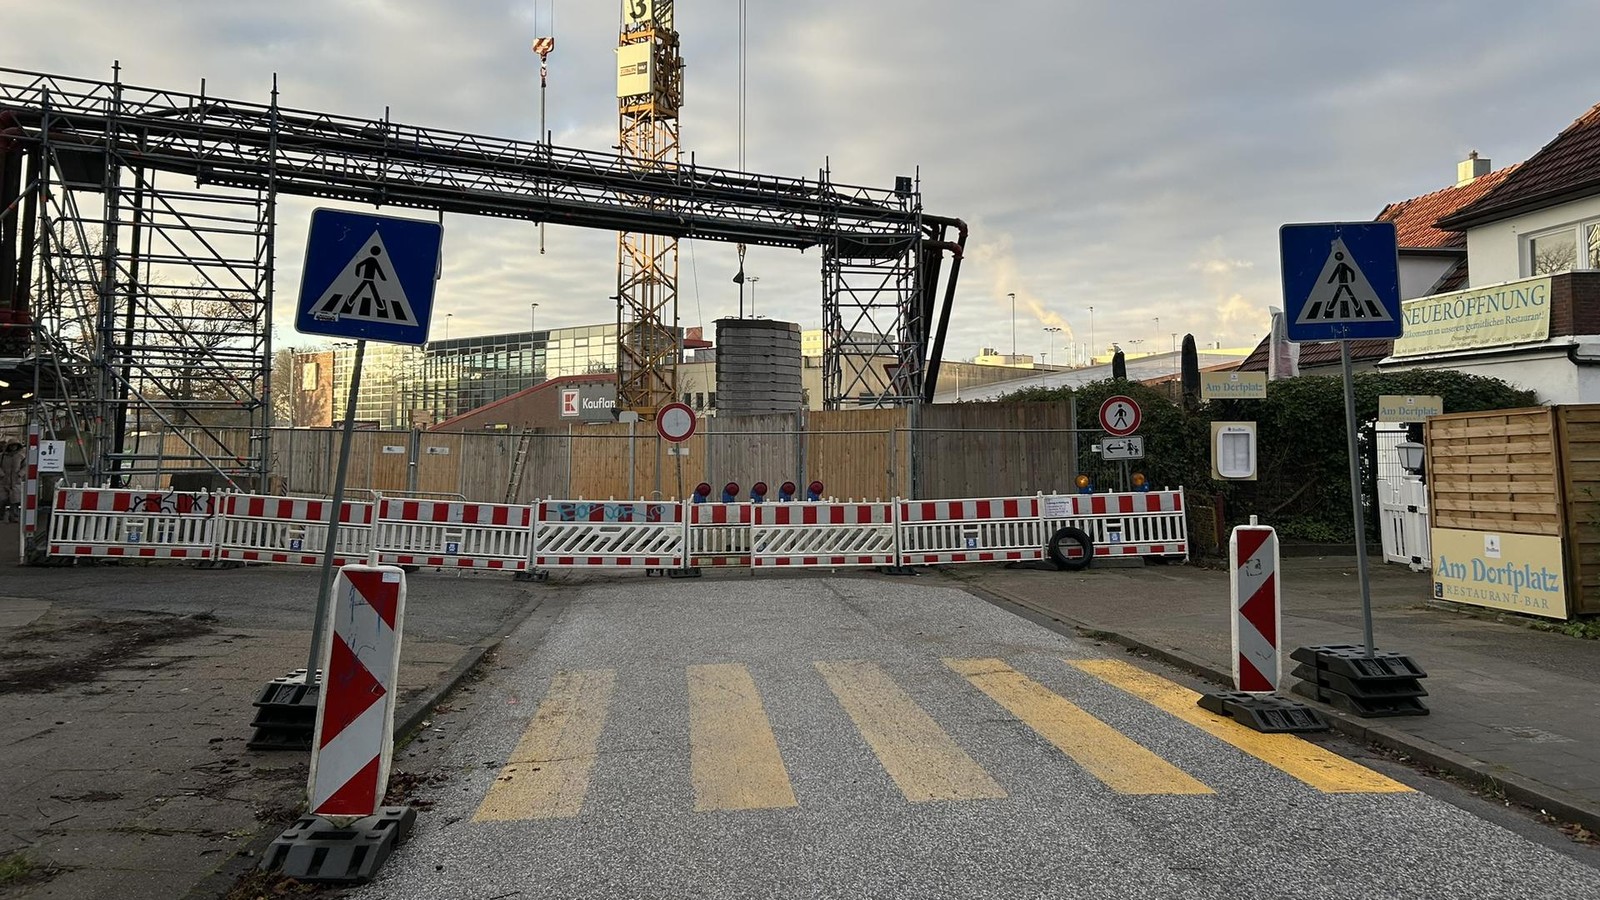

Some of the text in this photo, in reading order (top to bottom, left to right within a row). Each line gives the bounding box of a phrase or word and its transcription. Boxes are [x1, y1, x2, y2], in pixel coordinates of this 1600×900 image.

[1402, 285, 1545, 326] NEUERÖFFNUNG
[1403, 329, 1433, 338] illkommen
[1206, 383, 1263, 392] Am Dorfplatz
[582, 397, 616, 409] Kauflan
[1381, 407, 1438, 417] Am Dorfplatz
[1437, 555, 1559, 593] Am Dorfplatz
